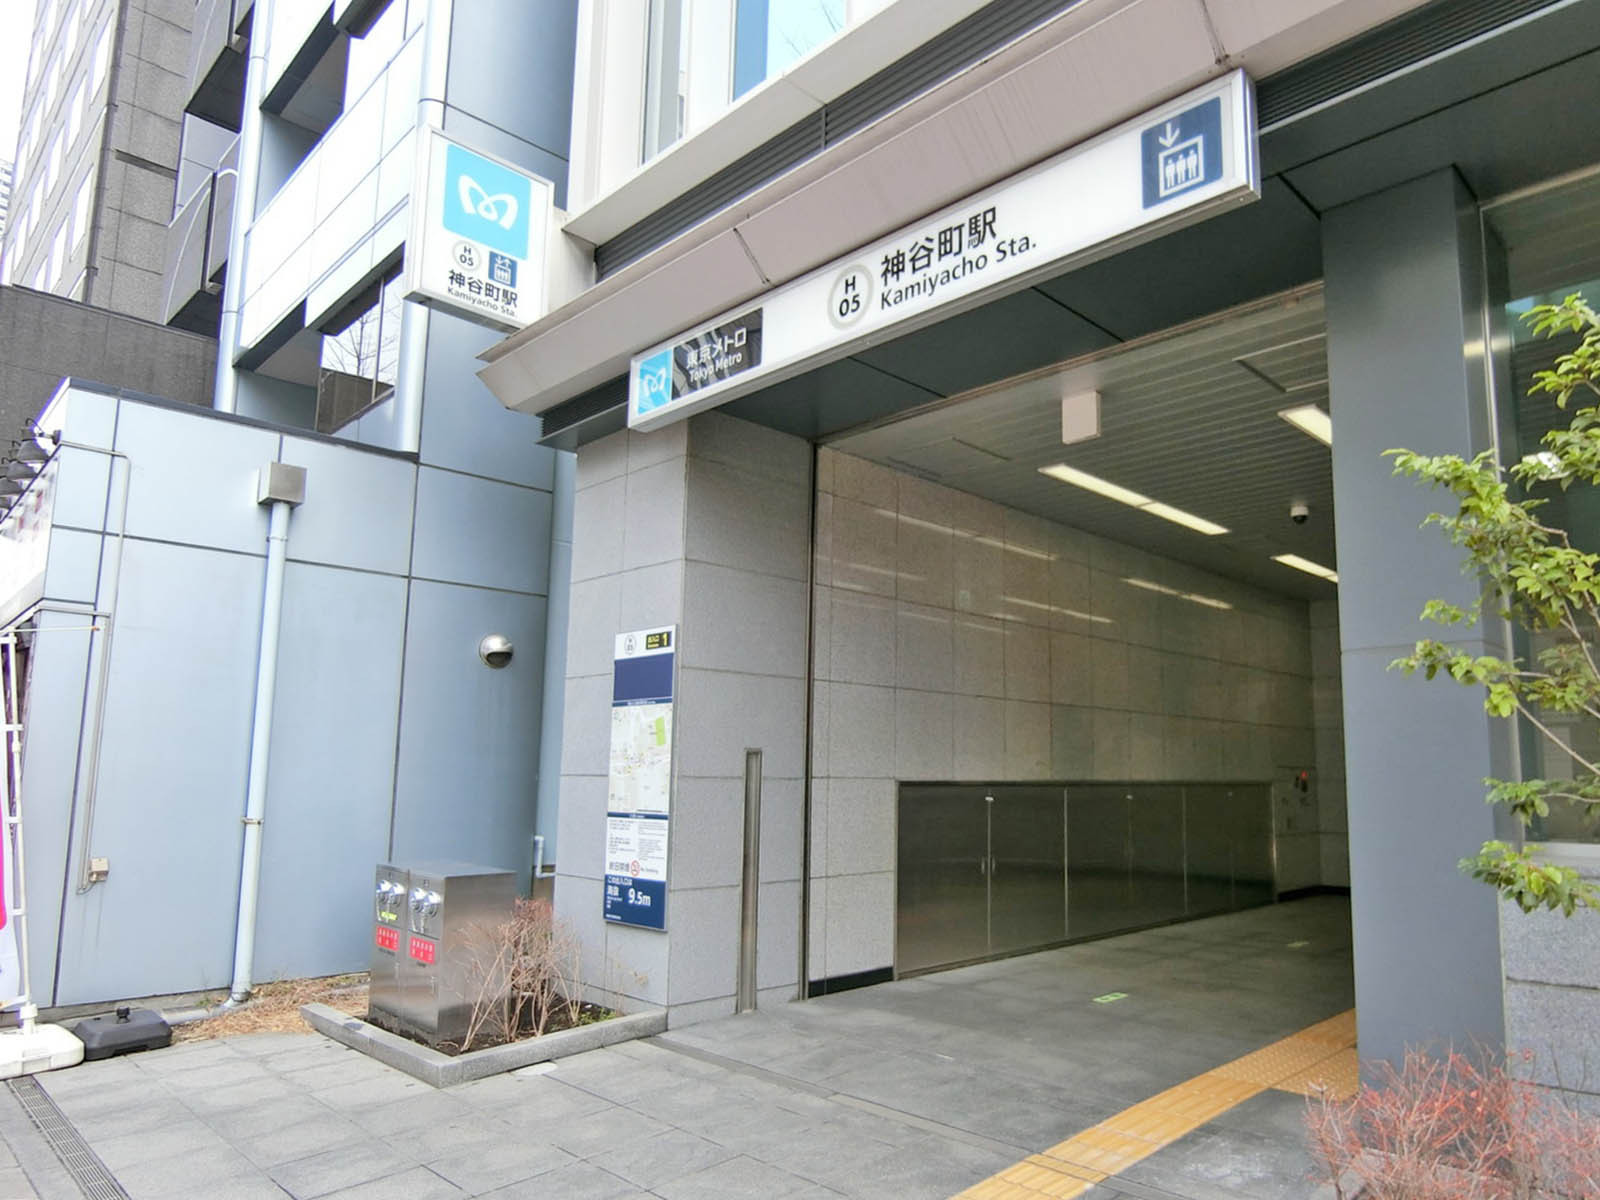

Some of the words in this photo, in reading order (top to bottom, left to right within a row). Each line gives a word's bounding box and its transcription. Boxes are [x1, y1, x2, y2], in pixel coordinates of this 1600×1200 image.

[463, 245, 472, 256] H
[879, 206, 998, 288] 神谷町駅
[459, 254, 474, 267] 05
[879, 253, 989, 311] Kamiyacho
[995, 235, 1038, 264] Sta.
[448, 269, 519, 309] 神谷町駅
[844, 275, 857, 295] H
[447, 286, 499, 312] Kamiyacho
[500, 305, 519, 320] Sta.
[838, 294, 861, 318] 05
[686, 327, 747, 369] 東京メトロ
[715, 352, 743, 372] Metro
[662, 632, 668, 647] 1
[628, 887, 652, 907] 9.5m
